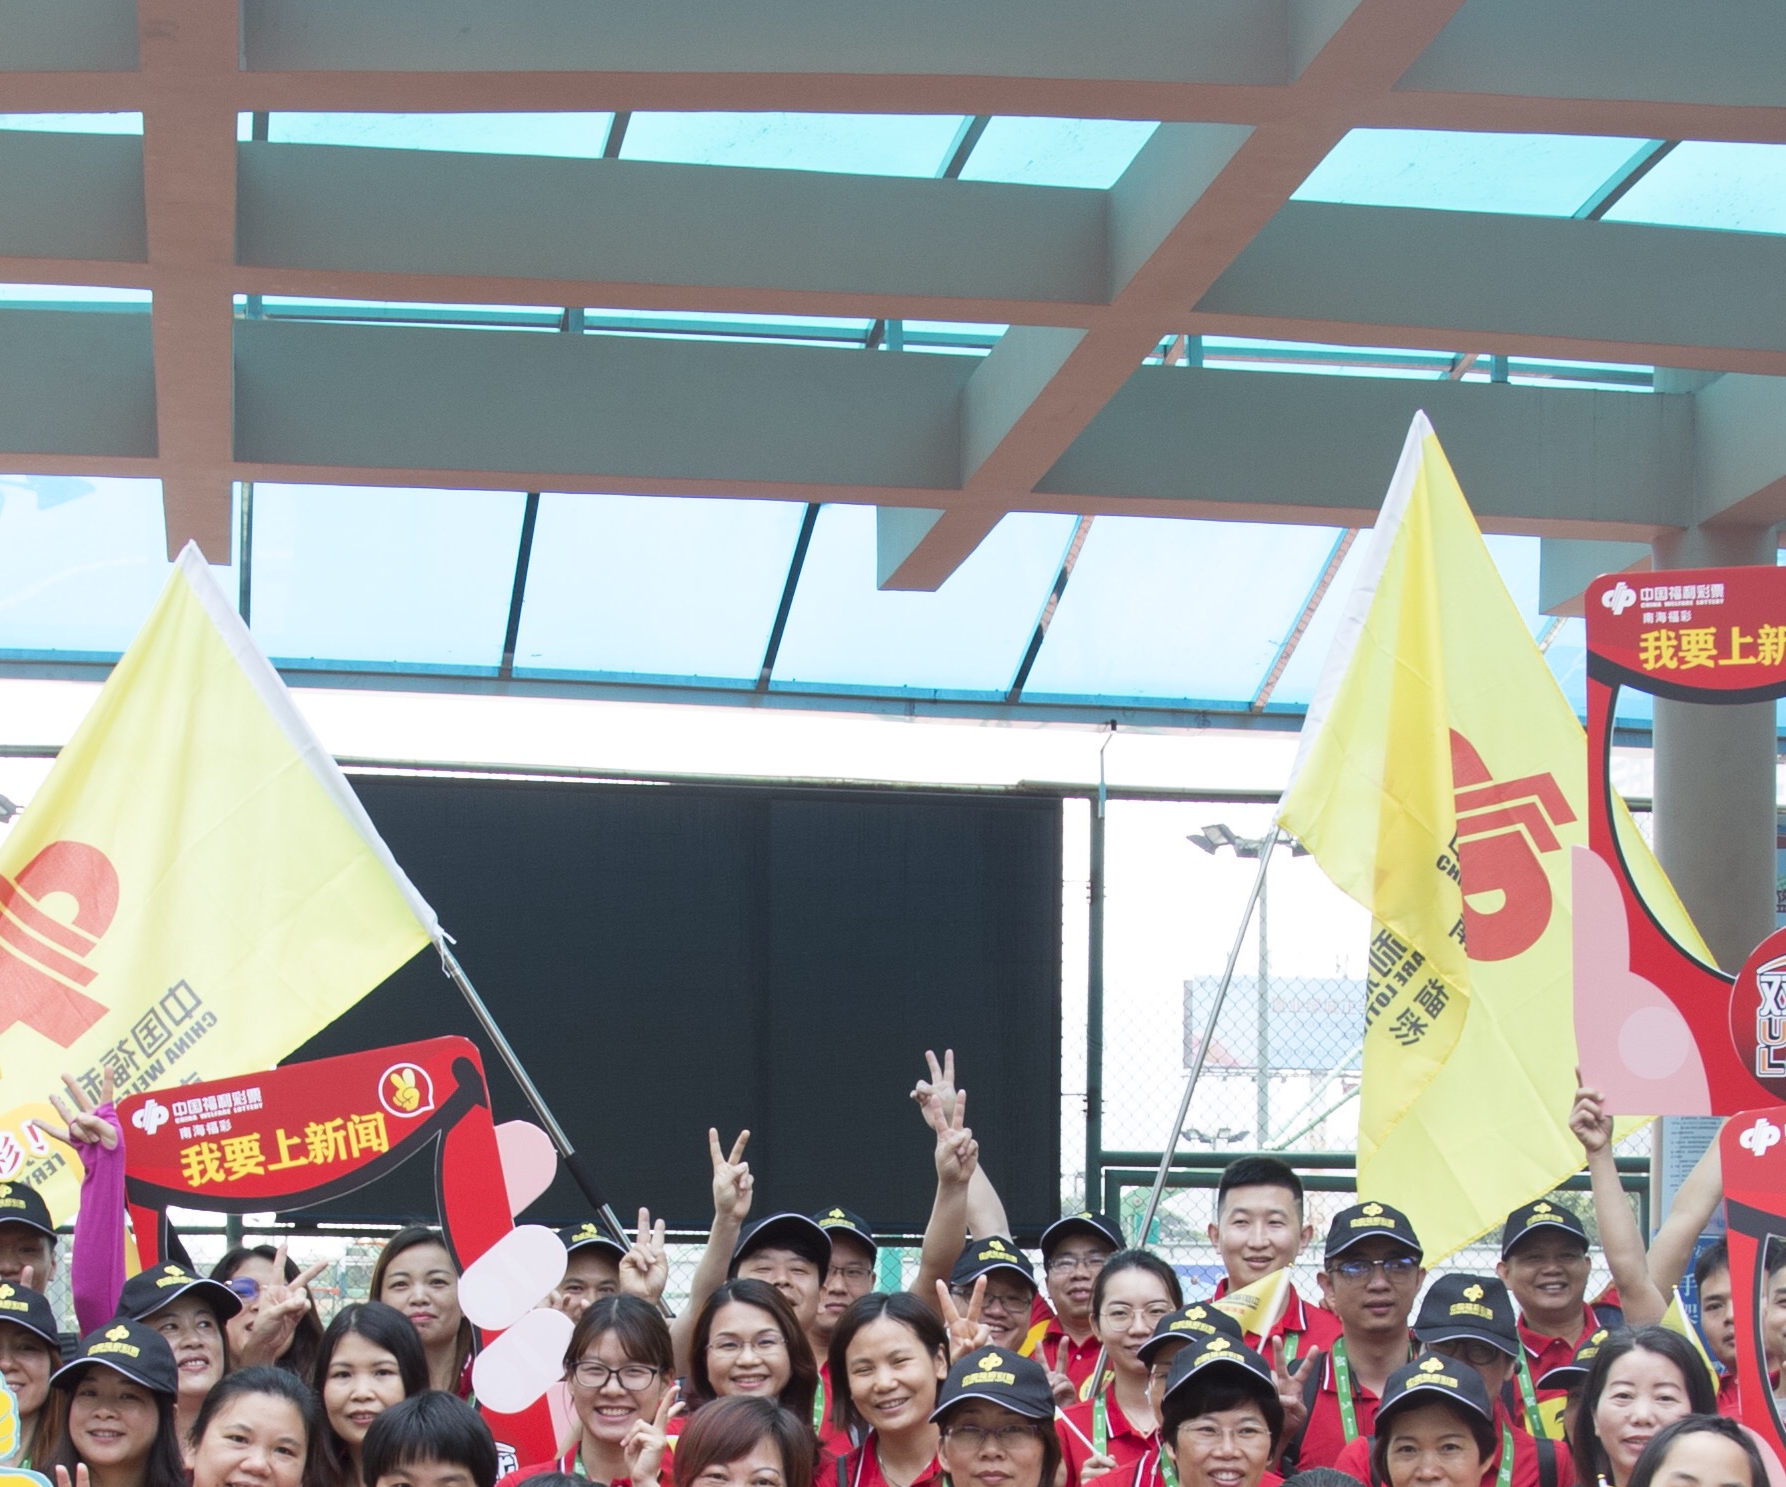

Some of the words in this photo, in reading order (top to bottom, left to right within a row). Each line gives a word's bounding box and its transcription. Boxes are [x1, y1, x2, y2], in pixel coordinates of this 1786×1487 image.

[1640, 584, 1725, 602] 中国福利彩票
[1643, 609, 1692, 624] 南海福彩
[171, 1087, 263, 1118] 中国福利彩票
[178, 1121, 233, 1141] 南海福彩
[179, 1111, 390, 1188] 我要上新闻
